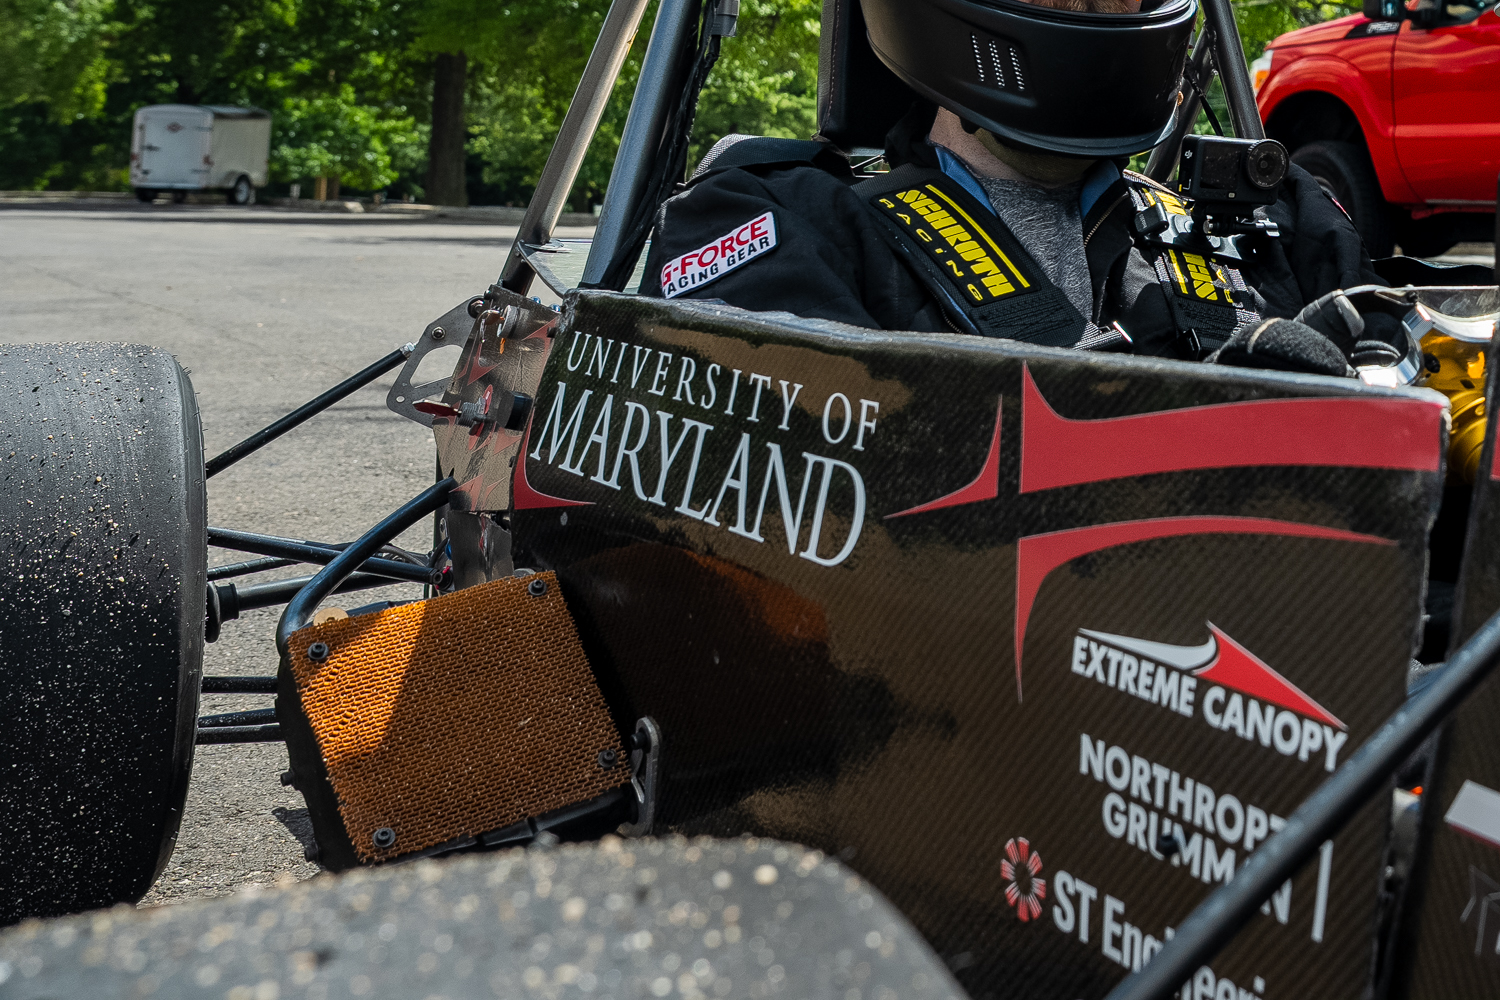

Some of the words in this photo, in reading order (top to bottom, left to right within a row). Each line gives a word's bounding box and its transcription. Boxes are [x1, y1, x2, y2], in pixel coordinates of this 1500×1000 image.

[662, 215, 769, 288] G-FORCE
[663, 262, 719, 297] ACING
[726, 236, 770, 267] GEAR
[896, 189, 1016, 297] SCHROTH
[566, 330, 805, 432] UNIVERSITY
[821, 392, 880, 451] OF
[529, 381, 867, 568] MARYLAND
[1070, 635, 1198, 718] EXTREME
[1202, 686, 1349, 772] CANOPY
[1079, 732, 1269, 851] NORTHROP
[1052, 870, 1099, 944] ST
[1102, 791, 1293, 925] GRUMMN
